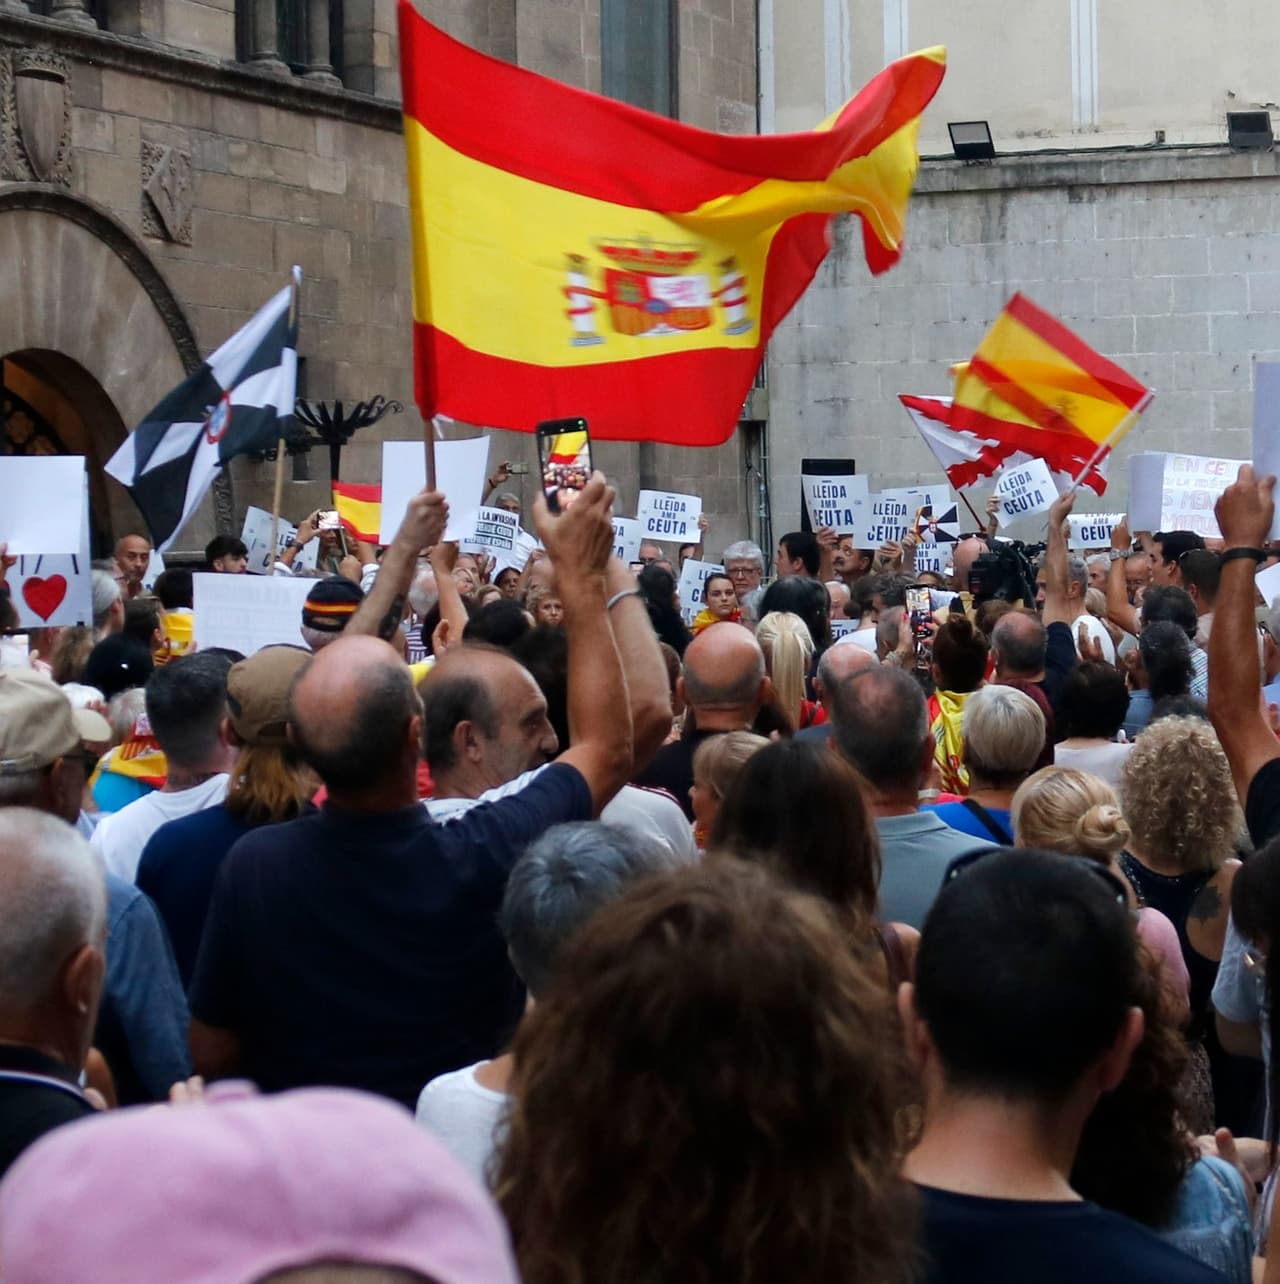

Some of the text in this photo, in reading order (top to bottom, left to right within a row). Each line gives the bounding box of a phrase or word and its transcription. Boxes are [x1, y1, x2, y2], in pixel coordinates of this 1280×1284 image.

[999, 471, 1032, 493] LLEIDA
[813, 485, 847, 498] LLEIDA
[1011, 487, 1027, 498] AMB
[654, 499, 686, 512] LLEIDA
[821, 499, 837, 508] AMB
[1004, 490, 1045, 515] CEUTA
[873, 503, 907, 516] LLEIDA
[648, 518, 687, 535] CEUTA
[882, 516, 898, 525] AMB
[1081, 525, 1113, 541] CEUT
[913, 558, 940, 572] EUTA
